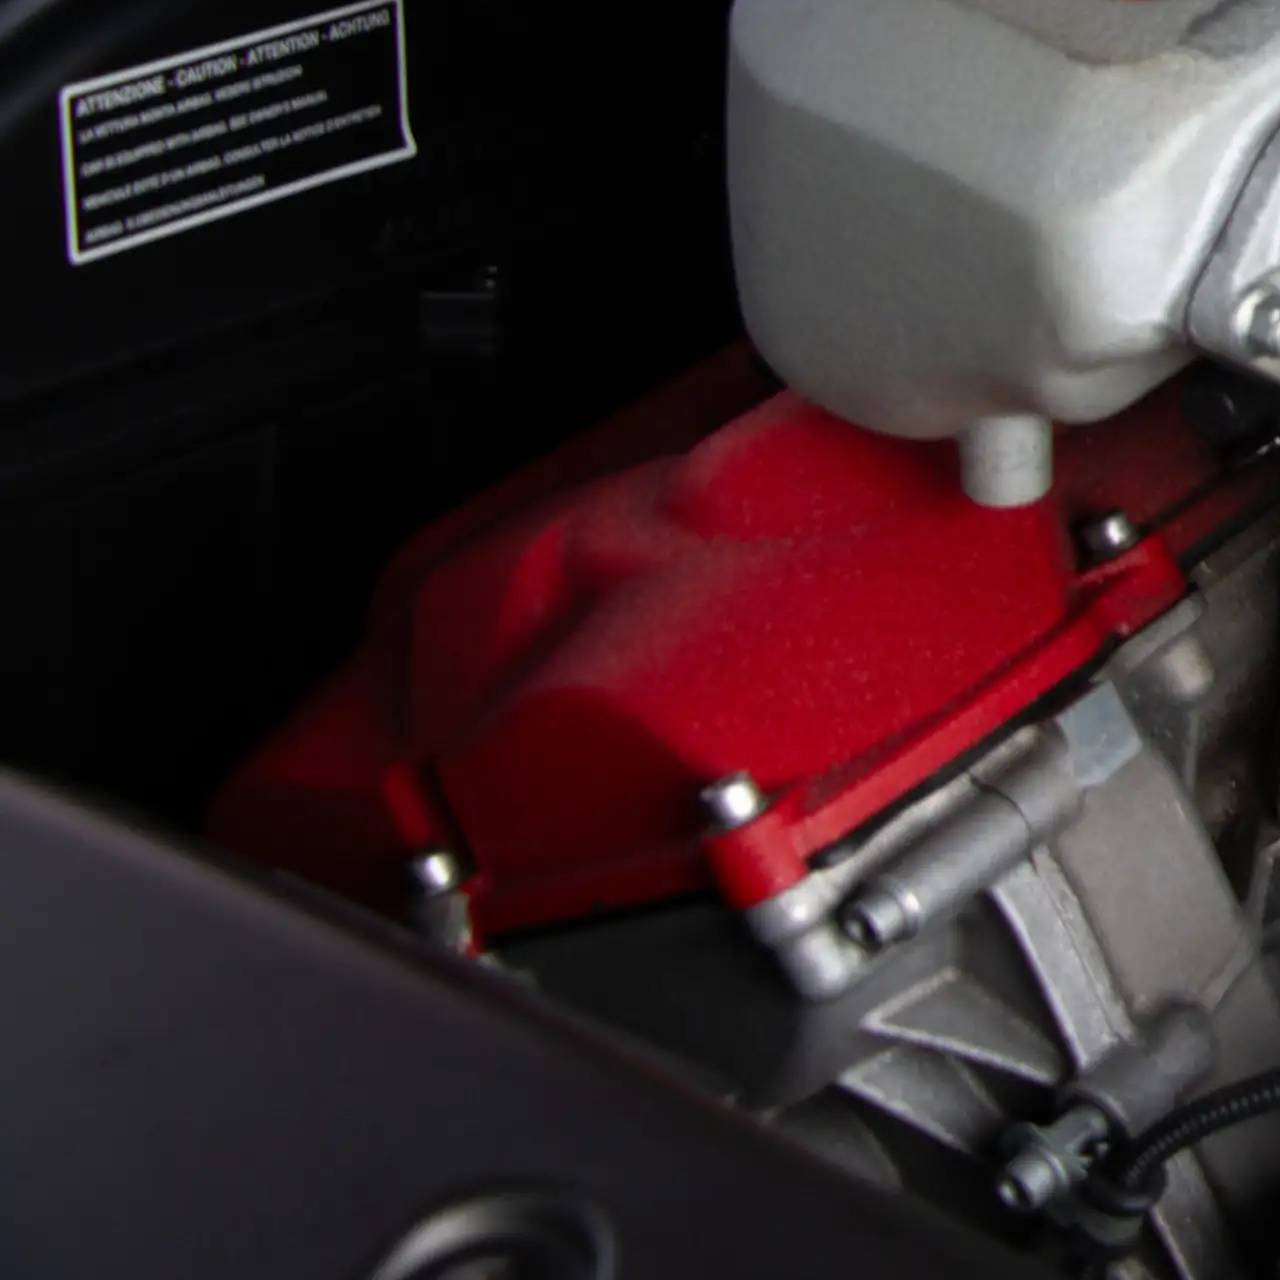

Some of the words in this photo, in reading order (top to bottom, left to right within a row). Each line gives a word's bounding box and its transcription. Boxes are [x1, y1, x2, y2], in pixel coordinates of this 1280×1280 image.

[74, 74, 165, 117] ATTENZIONE
[175, 53, 237, 87] CAUTION
[246, 29, 320, 65] ATTENTION
[328, 8, 390, 41] ACHTUNG
